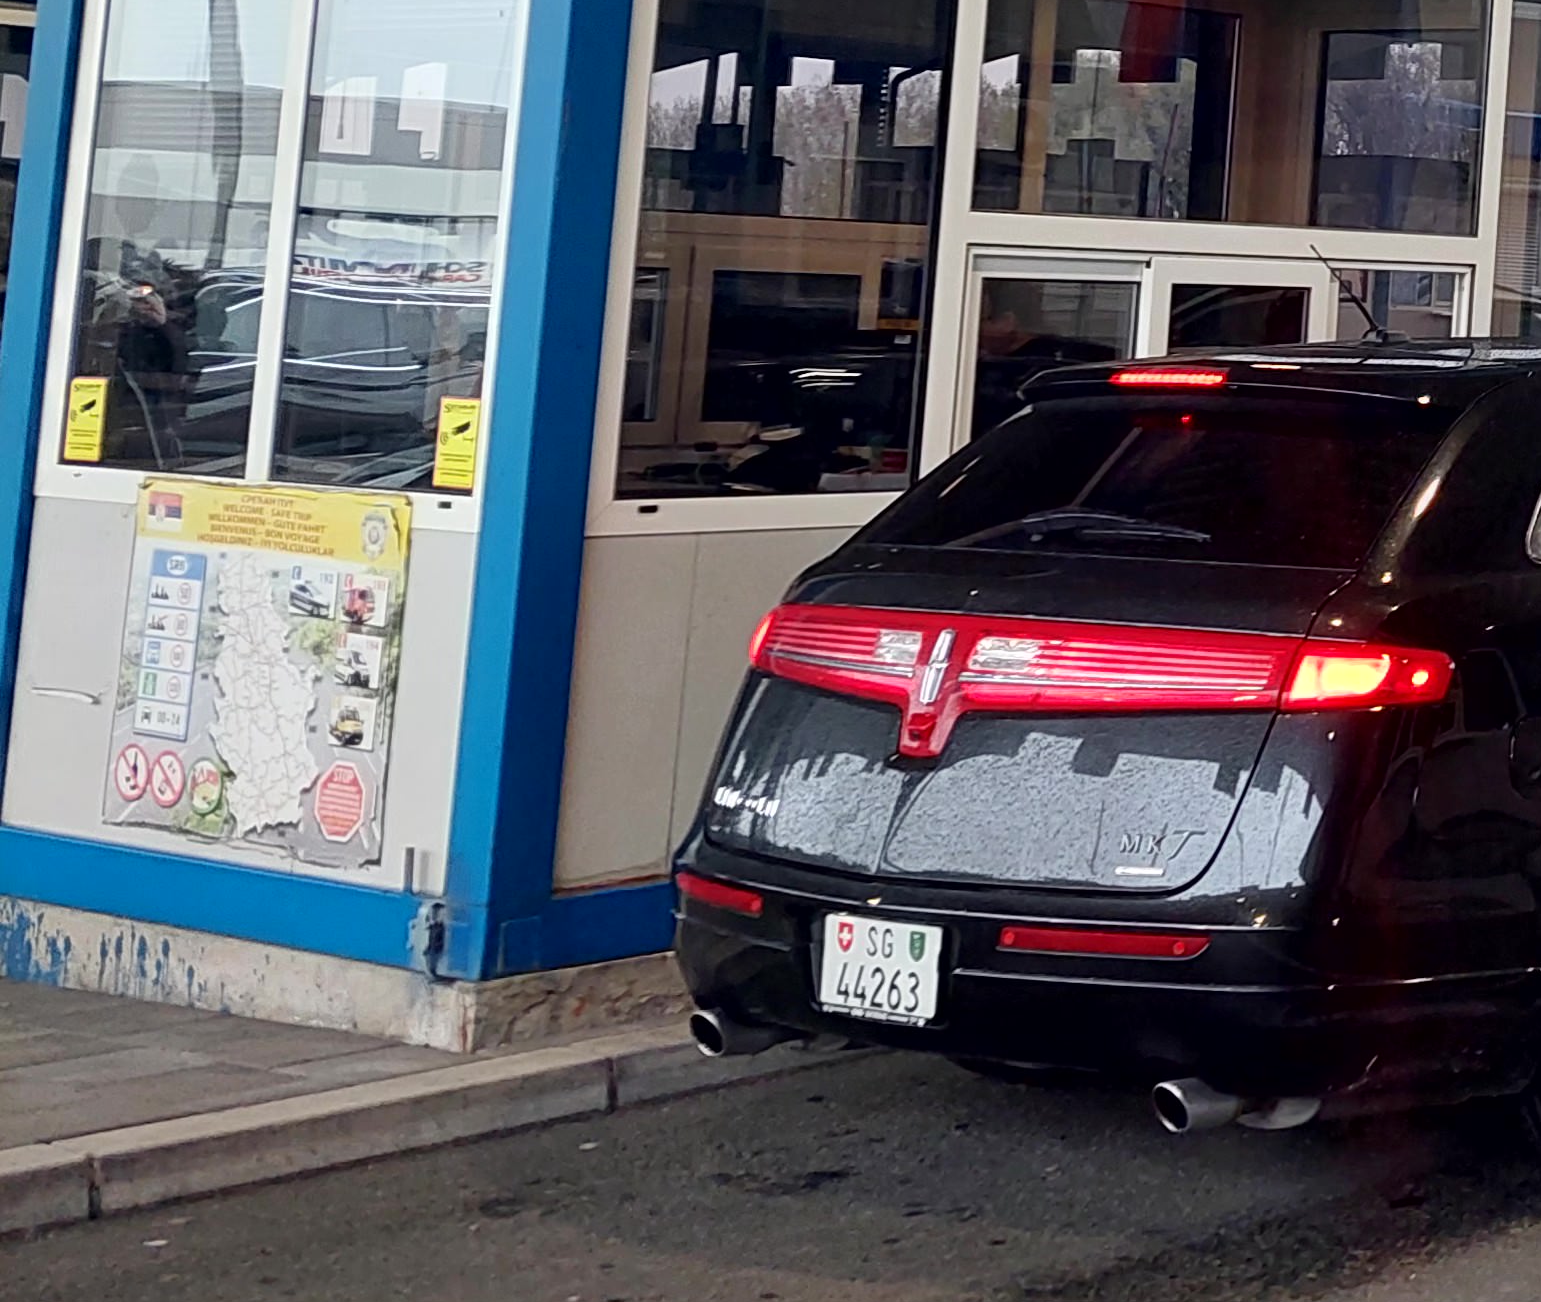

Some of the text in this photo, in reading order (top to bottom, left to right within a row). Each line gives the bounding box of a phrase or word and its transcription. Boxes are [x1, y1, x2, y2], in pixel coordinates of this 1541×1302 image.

[208, 513, 266, 526] WILLKOMMEN
[273, 519, 296, 530] GUTE
[297, 522, 327, 534] FAHRT
[223, 504, 265, 515] WELCOME
[271, 509, 292, 519] SAFE
[293, 511, 312, 521] TRIP
[264, 528, 283, 539] BON
[284, 531, 321, 544] VOYAGE
[1119, 829, 1208, 862] MKT
[866, 926, 894, 959] SG
[836, 962, 920, 1013] 44263
